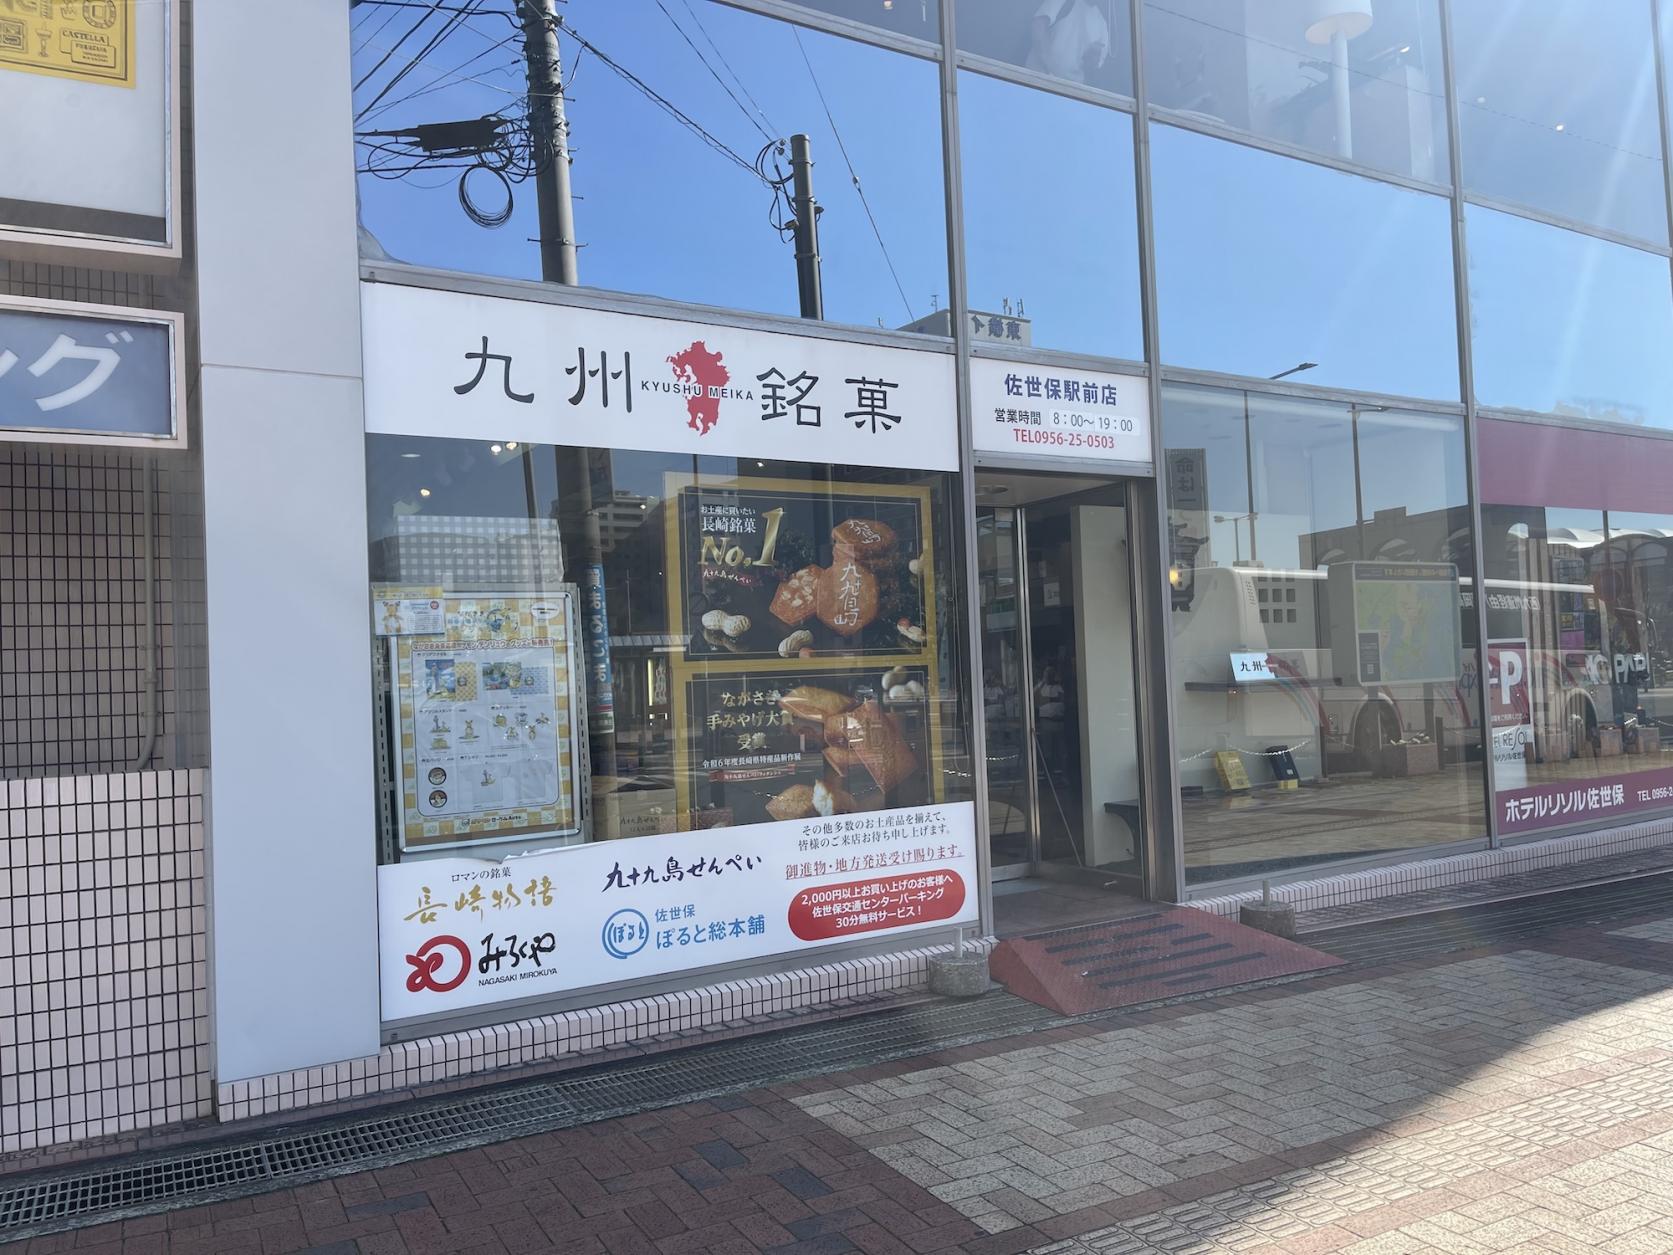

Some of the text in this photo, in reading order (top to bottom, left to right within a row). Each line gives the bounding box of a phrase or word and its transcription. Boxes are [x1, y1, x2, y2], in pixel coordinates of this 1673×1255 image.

[62, 29, 106, 43] CASTELLA
[0, 331, 133, 411] グ
[454, 336, 902, 433] 九州 KYUSHU MEIKA 銘菓
[1004, 372, 1117, 406] 佐世保駅前店
[994, 408, 1042, 426] 営業時間
[1013, 428, 1115, 449] TEL0956-25-0503
[702, 517, 756, 533] 長崎銘菓
[1240, 661, 1263, 672] 九州
[1505, 784, 1673, 823] ホテルリソル佐世保 TEL 0956-2
[802, 811, 946, 836] その他多数のお土産品を揃えて、
[798, 824, 950, 852] 皆様のご来店お待ち申し上げます。
[451, 866, 512, 882] ロマンの銘菓
[601, 855, 763, 893] 九十九島せんぺい
[801, 874, 953, 905] 2,000円以上お買い上げのお客様へ
[654, 904, 696, 923] 佐世保
[656, 914, 766, 950] ぽると総本舗
[478, 932, 556, 974] みろくや
[478, 967, 558, 987] NAGASAKI MIROKUYA
